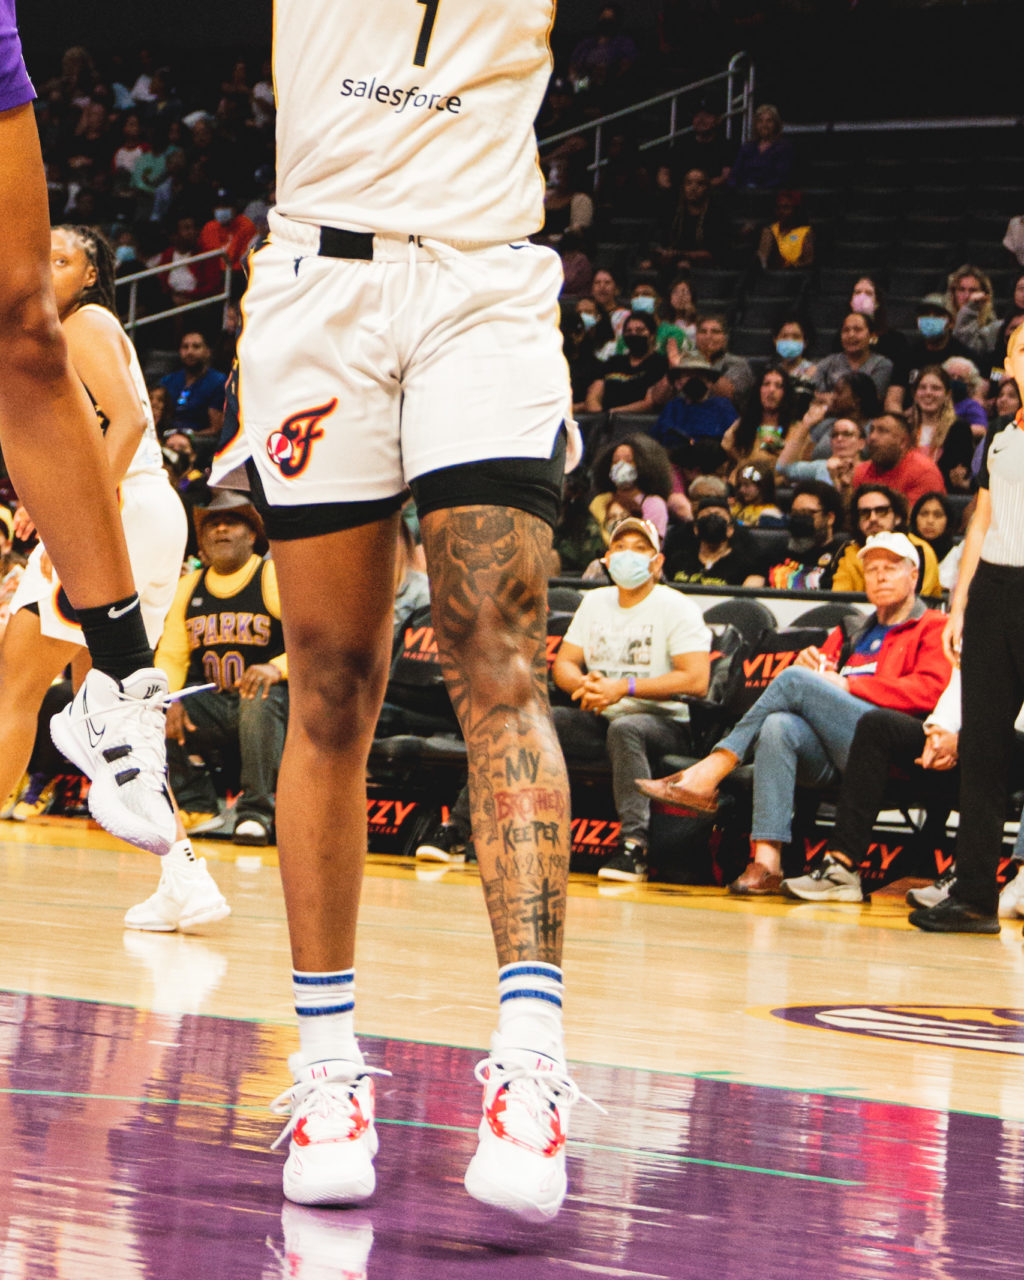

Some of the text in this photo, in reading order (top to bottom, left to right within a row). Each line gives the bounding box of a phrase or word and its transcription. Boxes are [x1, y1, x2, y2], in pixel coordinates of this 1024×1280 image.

[340, 77, 462, 114] salesforce
[742, 650, 796, 679] VIZ
[505, 748, 541, 787] MY
[501, 819, 561, 855] KEEPER
